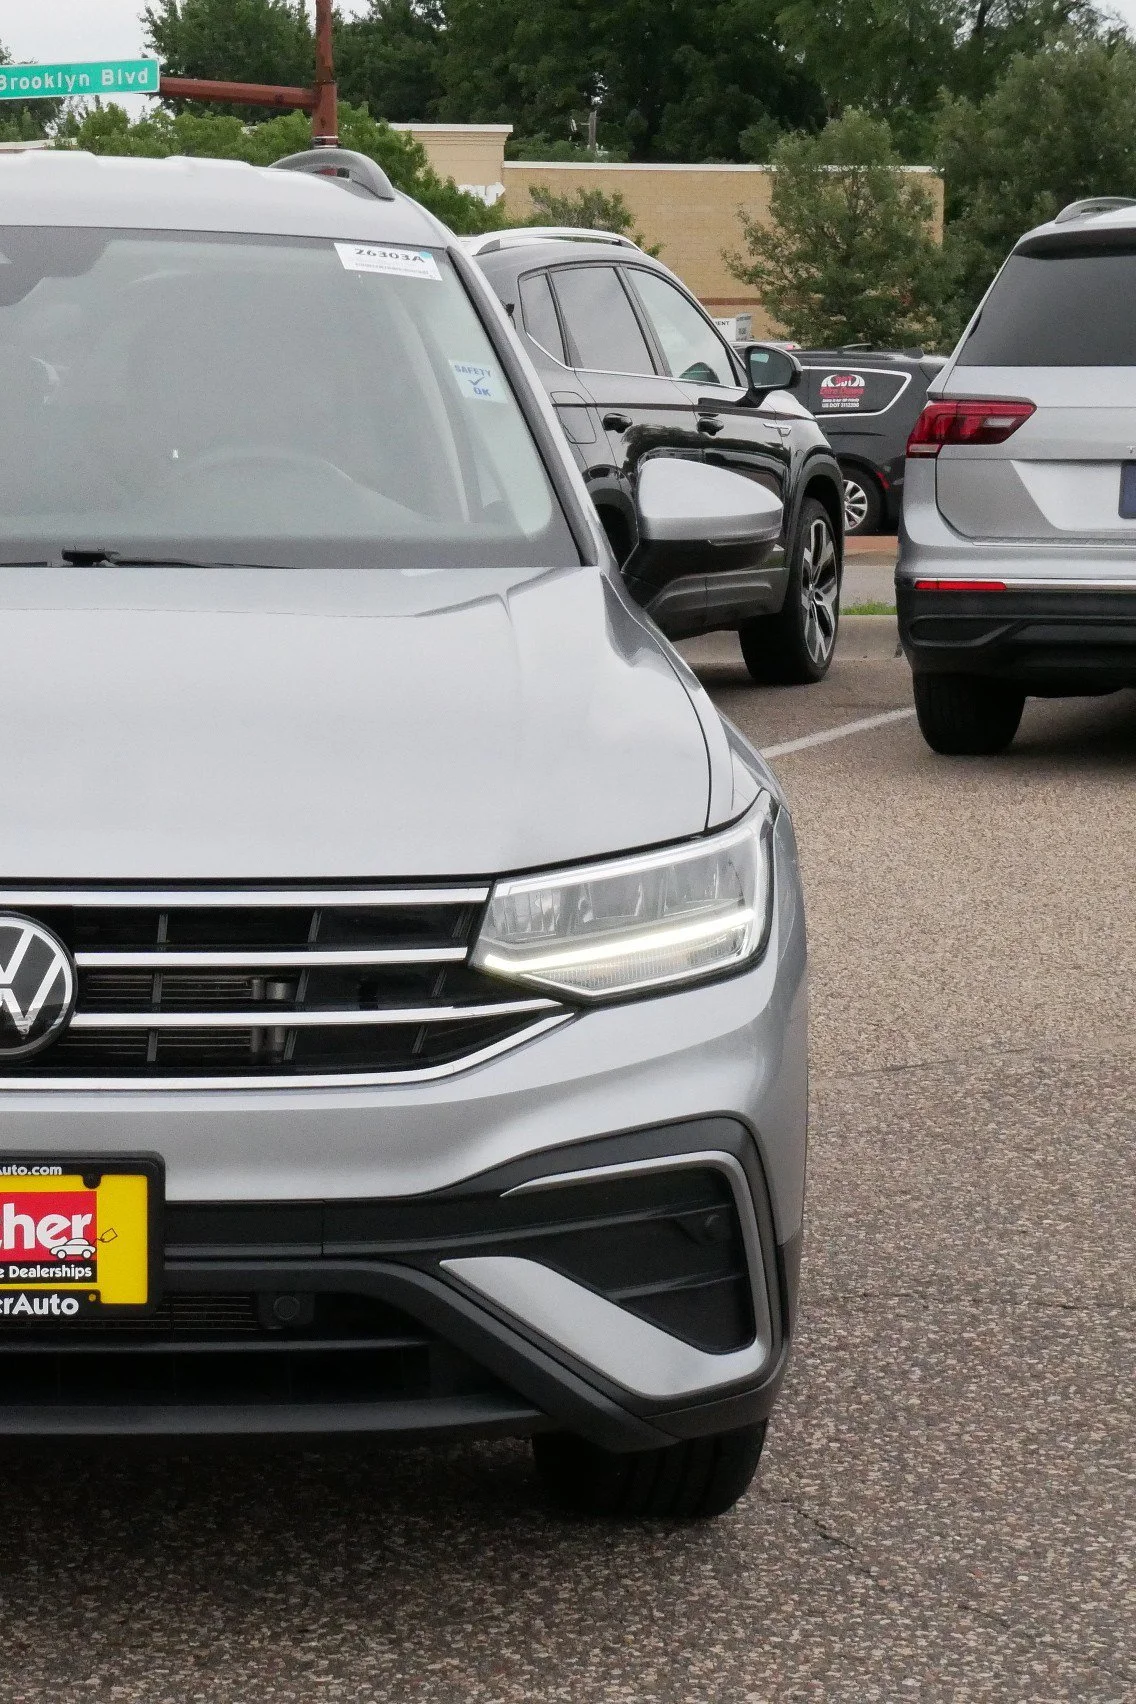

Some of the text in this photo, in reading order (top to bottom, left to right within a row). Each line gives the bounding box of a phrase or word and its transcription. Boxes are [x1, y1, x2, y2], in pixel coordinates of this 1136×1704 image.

[100, 67, 149, 86] Blvd
[454, 364, 492, 378] SAFETY
[473, 386, 492, 397] OK
[8, 1264, 92, 1280] Dealerships
